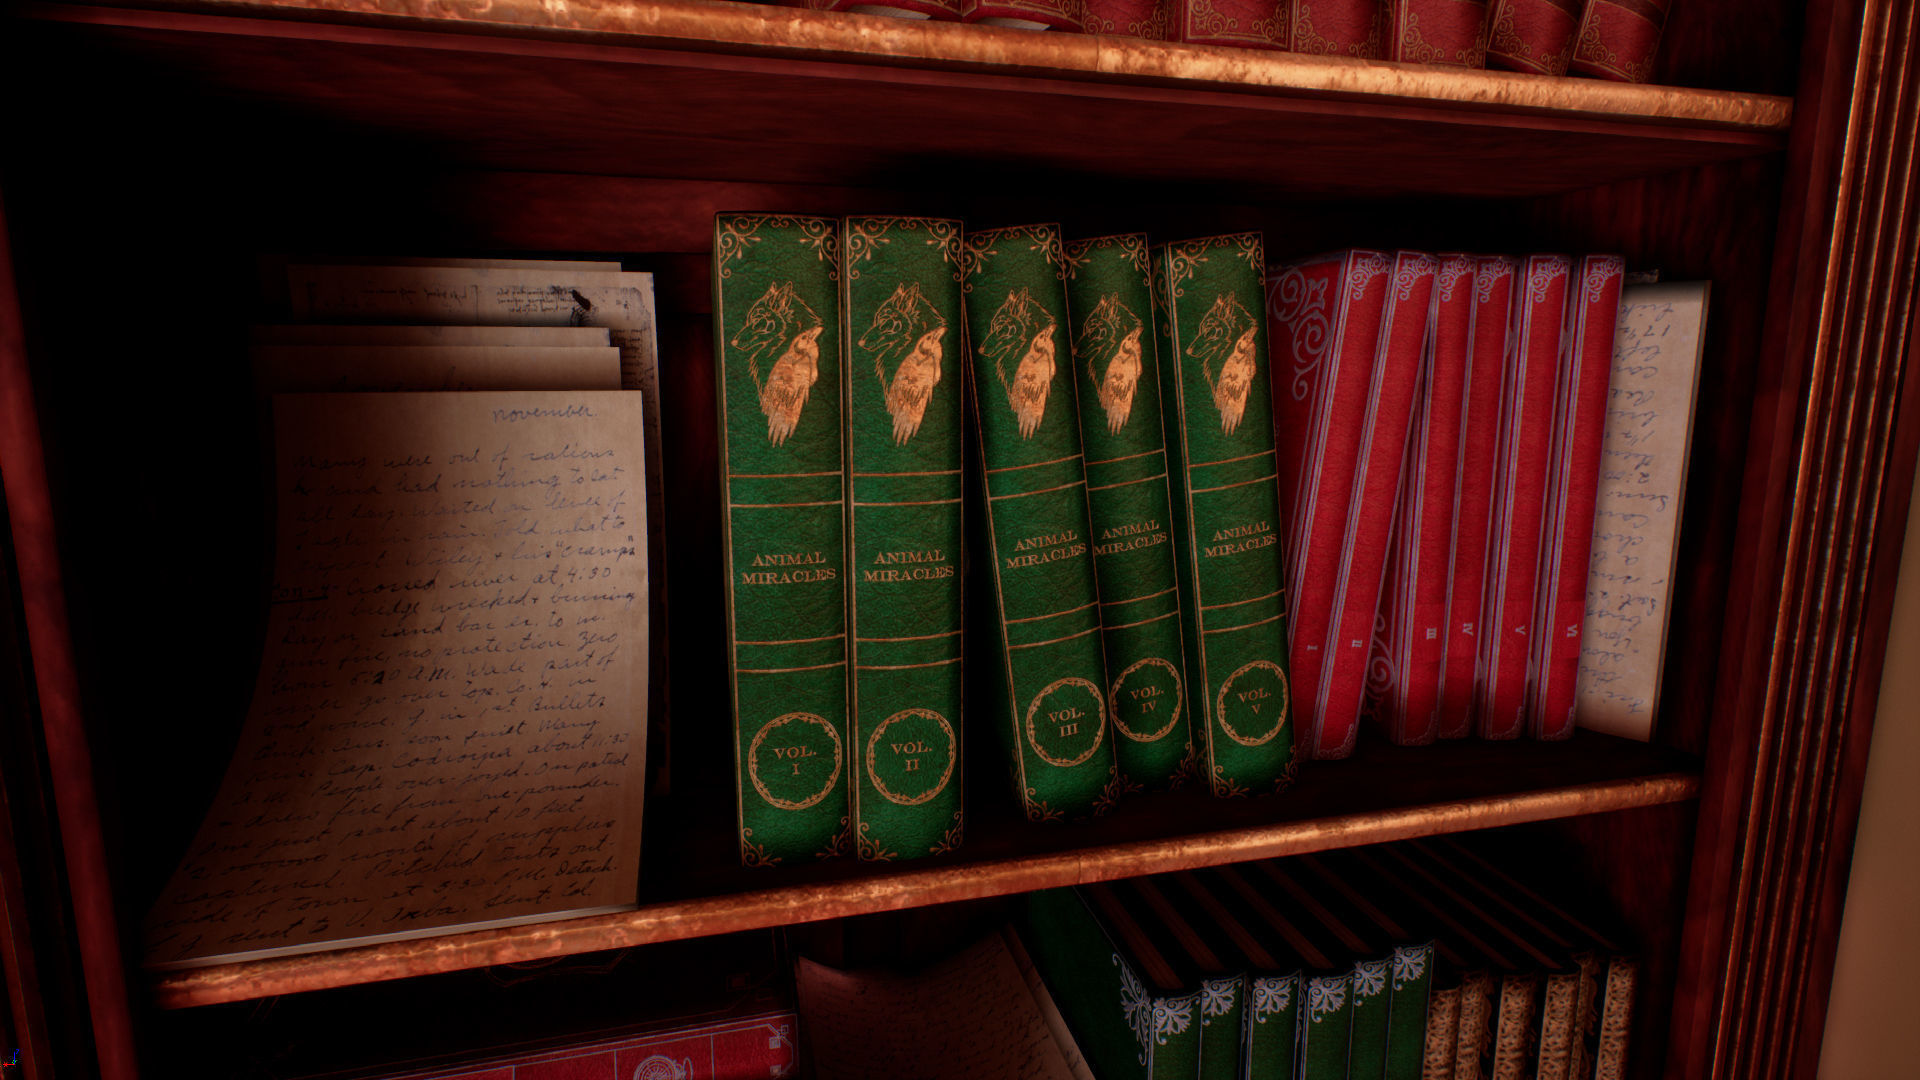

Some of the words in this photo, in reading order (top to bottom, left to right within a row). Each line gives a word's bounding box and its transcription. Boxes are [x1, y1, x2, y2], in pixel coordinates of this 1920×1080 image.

[491, 442, 511, 472] of
[607, 490, 627, 514] of
[1101, 520, 1160, 543] ANIMAL
[1213, 520, 1270, 543] ANIMAL
[1014, 529, 1078, 552] ANIMAL
[1094, 530, 1168, 557] MIRACLES
[1205, 533, 1279, 559] MIRACLES
[752, 551, 826, 568] ANIMAL
[874, 550, 945, 566] ANIMAL
[1006, 541, 1087, 569] MIRACLES
[742, 567, 836, 585] MIRACLES
[863, 565, 955, 583] MIRACLES
[1426, 626, 1438, 641] III
[1462, 621, 1475, 637] IV
[1514, 624, 1527, 637] V
[1567, 623, 1580, 639] VI
[1351, 638, 1364, 649] II
[1130, 685, 1164, 701] VOL.
[1238, 688, 1272, 704] VOL.
[1141, 699, 1158, 715] IV
[1250, 702, 1262, 716] V
[1048, 708, 1086, 725] VOL.
[1059, 722, 1080, 738] III
[773, 745, 818, 760] VOL.
[891, 741, 933, 757] VOL.
[792, 762, 801, 777] I
[905, 757, 920, 772] II
